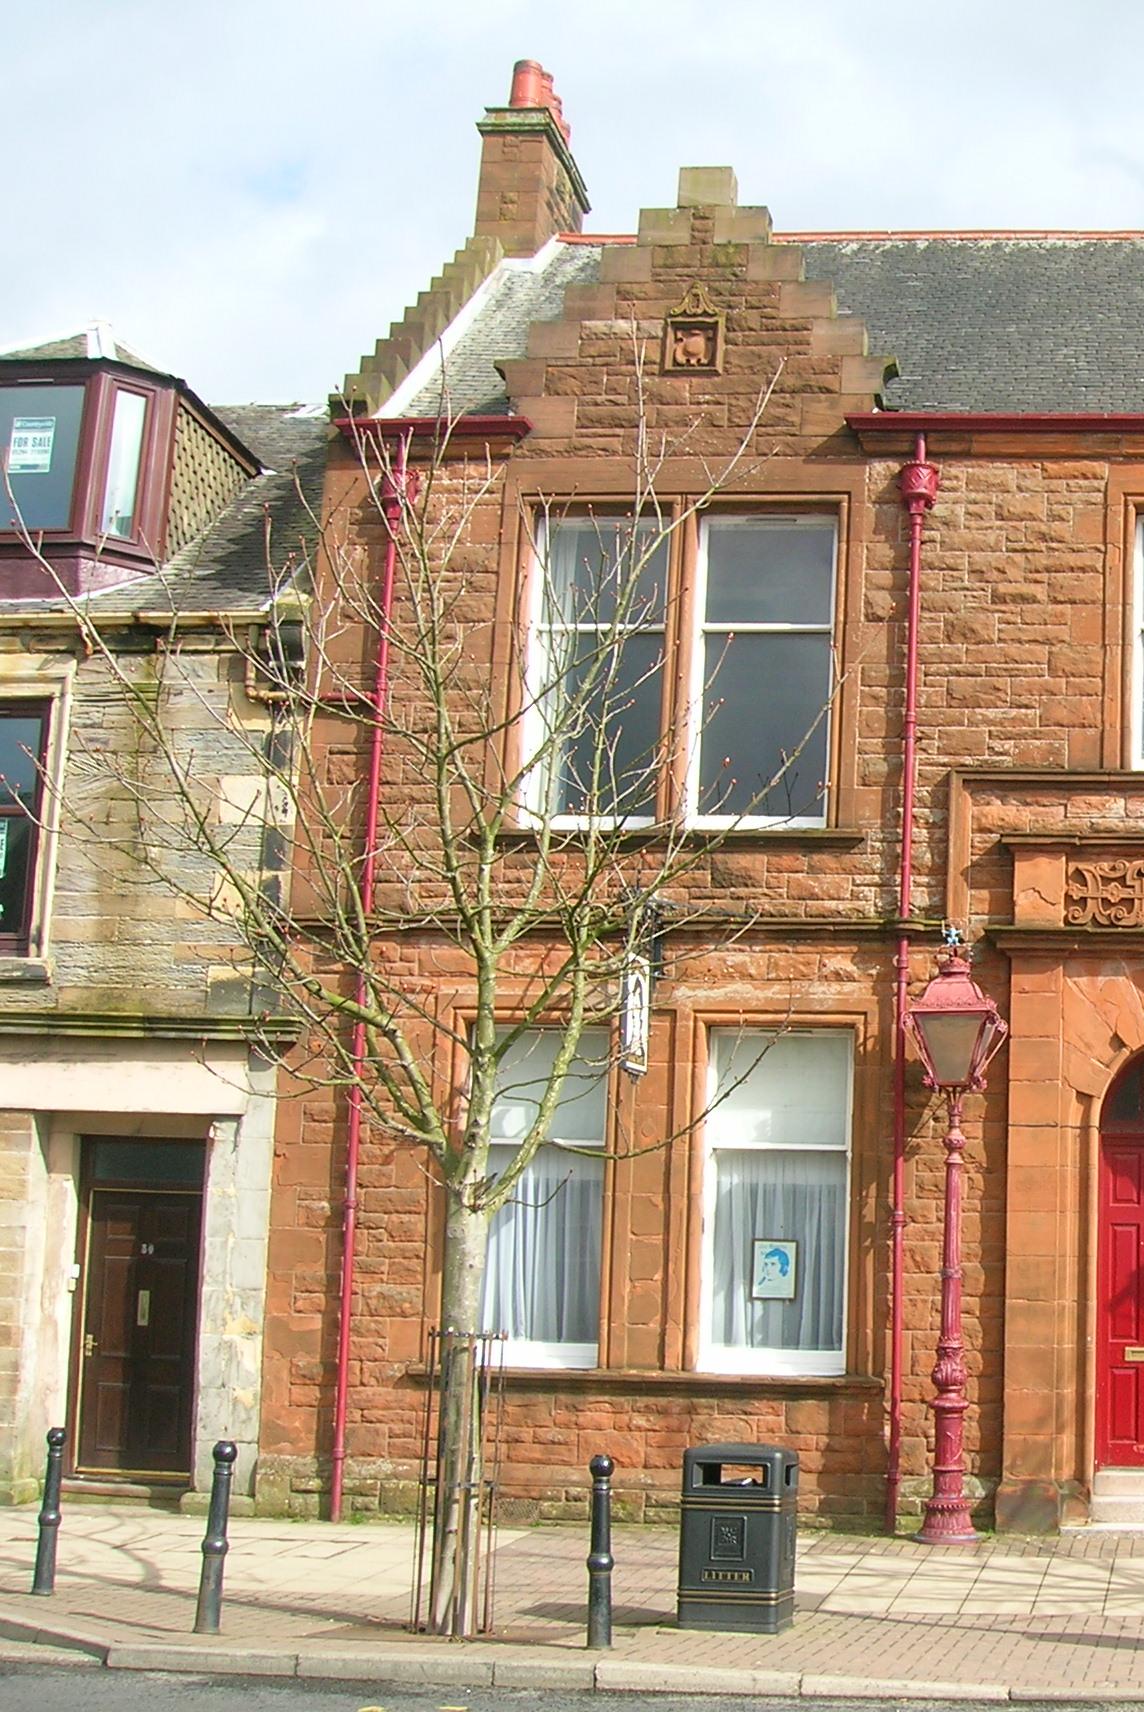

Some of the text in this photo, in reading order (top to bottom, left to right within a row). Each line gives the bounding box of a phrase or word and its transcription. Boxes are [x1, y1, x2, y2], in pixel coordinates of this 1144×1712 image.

[13, 437, 51, 448] FOR SALE
[704, 1570, 751, 1582] LITTER
